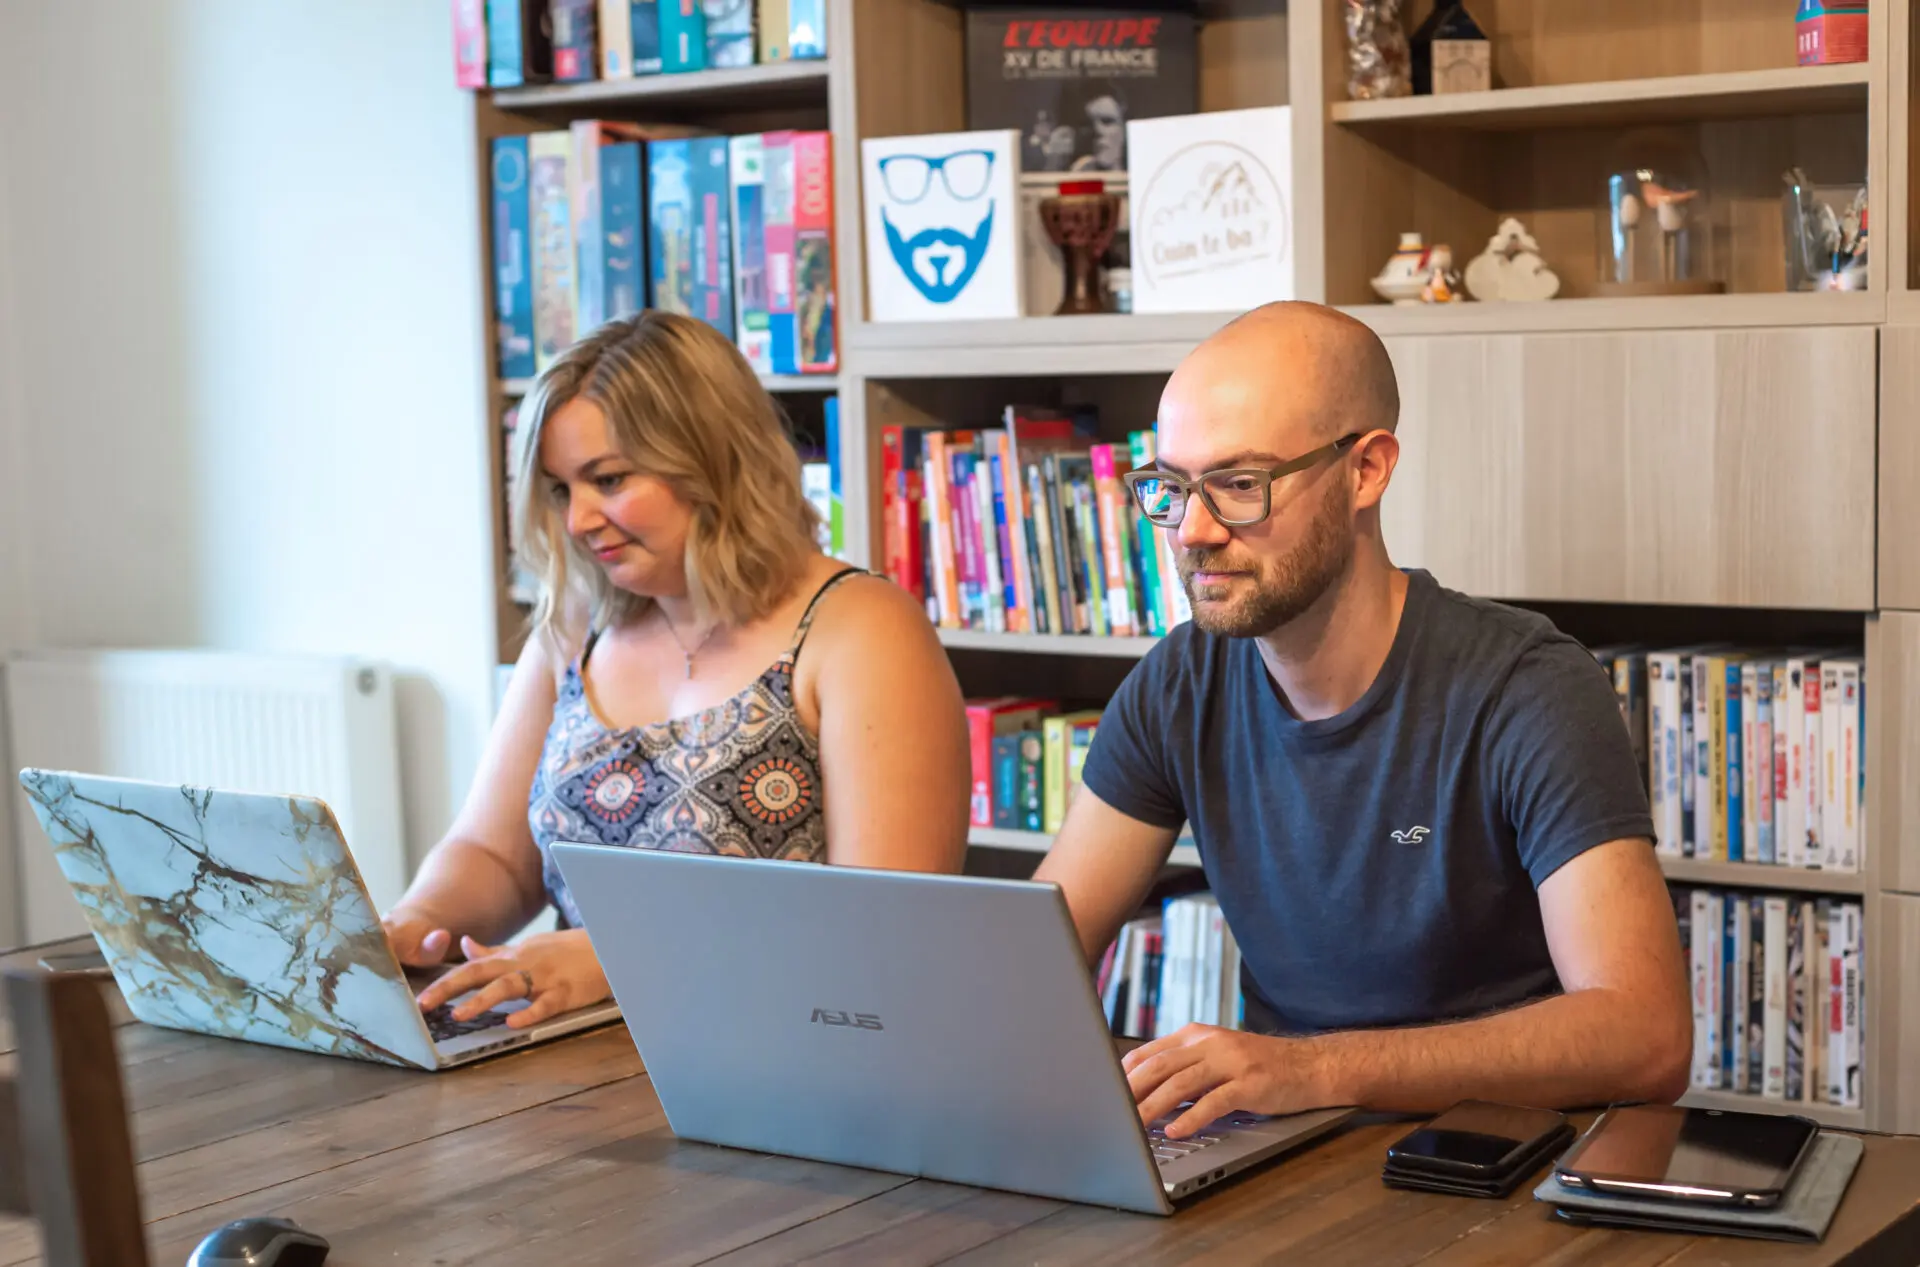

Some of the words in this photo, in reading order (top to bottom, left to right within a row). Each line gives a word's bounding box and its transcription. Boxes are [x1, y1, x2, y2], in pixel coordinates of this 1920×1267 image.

[1003, 49, 1032, 68] XV
[1037, 49, 1065, 69] DE
[1071, 48, 1157, 68] FRANCE
[811, 1007, 884, 1031] ASUS
